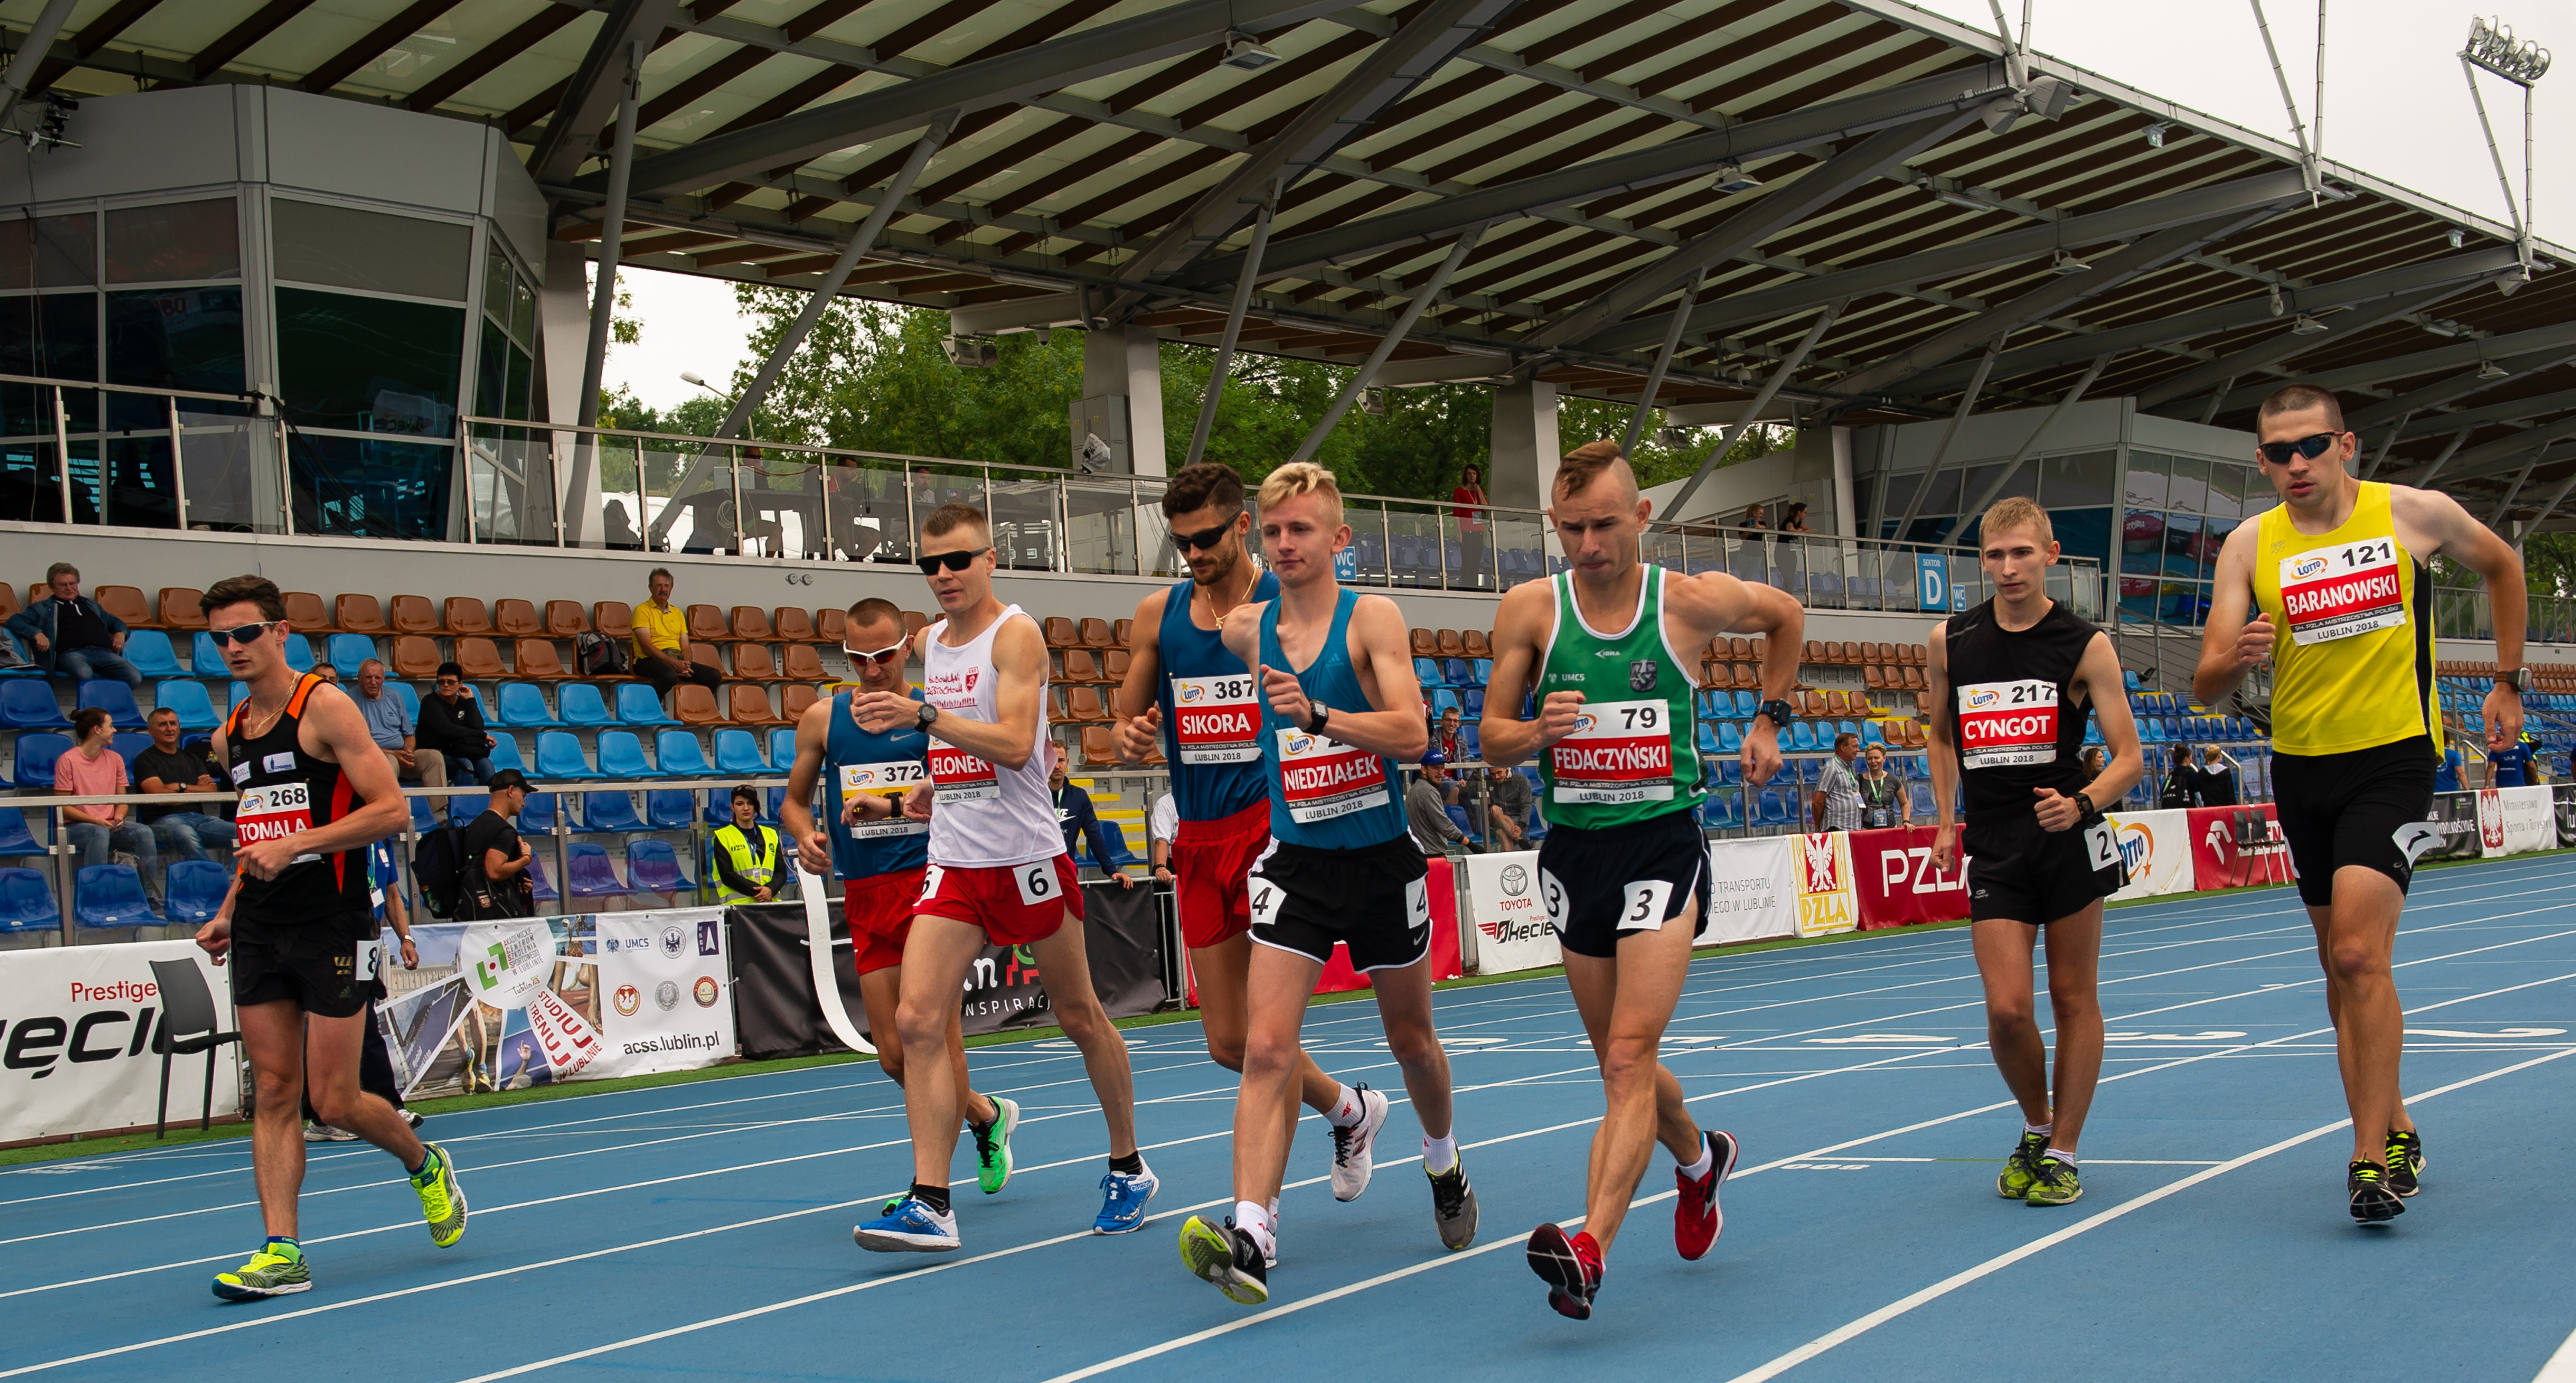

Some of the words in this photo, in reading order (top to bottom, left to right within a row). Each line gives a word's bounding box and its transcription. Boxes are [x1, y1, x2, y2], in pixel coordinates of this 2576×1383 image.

[1335, 552, 1354, 566] WC
[1923, 559, 1941, 567] SEKTOR
[2342, 542, 2390, 567] 121
[2297, 560, 2321, 576] LOTTO
[1925, 570, 1941, 604] D
[1953, 590, 1965, 600] WC
[2286, 574, 2397, 615] BARANOWSKI
[2306, 621, 2323, 629] PZLA
[2325, 611, 2374, 626] MISTRZOSTWA
[2374, 606, 2398, 616] POLSKI
[2318, 626, 2352, 640] LUBLIN
[2356, 620, 2379, 632] 2018
[1562, 673, 1586, 681] UMCS
[1184, 688, 1200, 700] LOTTO
[1215, 680, 1255, 699] 387
[1973, 694, 1993, 705] LOTTO
[2011, 684, 2056, 704] 217
[1182, 713, 1252, 735] SIKORA
[1620, 707, 1657, 729] 79
[1964, 715, 2051, 740] CYNGOT
[1289, 738, 1309, 751] LOTTO
[1553, 742, 1667, 771] FEDACZYŃSKI
[1980, 756, 2009, 765] LUBLIN
[2013, 755, 2034, 763] 2018
[853, 773, 869, 783] LOTTO
[884, 765, 923, 782] 372
[1283, 755, 1379, 791] NIEDZIAŁEK
[244, 797, 260, 809] LOTTO
[270, 788, 307, 807] 268
[964, 791, 981, 799] 2018
[1312, 792, 1359, 806] MISTRZOSTWA
[1359, 785, 1382, 795] POLSKI
[1579, 792, 1615, 802] LUBLIN
[1619, 791, 1644, 801] 2018
[1305, 807, 1339, 819] LUBLIN
[1341, 800, 1363, 813] 2018
[238, 818, 308, 841] TOMALA
[862, 829, 888, 837] LUBLIN
[2507, 821, 2525, 835] Sportu
[2096, 831, 2112, 862] 2
[1028, 867, 1049, 897] 6
[1718, 878, 1770, 894] TRANSPORTU
[1252, 887, 1273, 916] 4
[1415, 883, 1426, 915] 4
[1500, 898, 1533, 911] TOYOTA
[1548, 883, 1561, 917] 3
[1630, 889, 1654, 922] 3
[1732, 899, 1740, 912] W
[1743, 896, 1776, 911] LUBLINIE
[1801, 897, 1849, 927] PZLA
[503, 927, 533, 947] AKADEMICKIE
[506, 934, 535, 954] CENTRUM
[625, 938, 649, 949] UMCS
[368, 946, 378, 974] 8
[508, 942, 537, 961] SZKOLENIA
[509, 949, 540, 969] SPORTOWEGO
[511, 968, 518, 976] W
[519, 955, 544, 973] LUBLINIE
[538, 991, 594, 1049] STUDIUJ
[530, 1004, 571, 1067] TRENUJ
[623, 1031, 720, 1055] acss.lublin.pl
[569, 1041, 603, 1076] LUBLINIE
